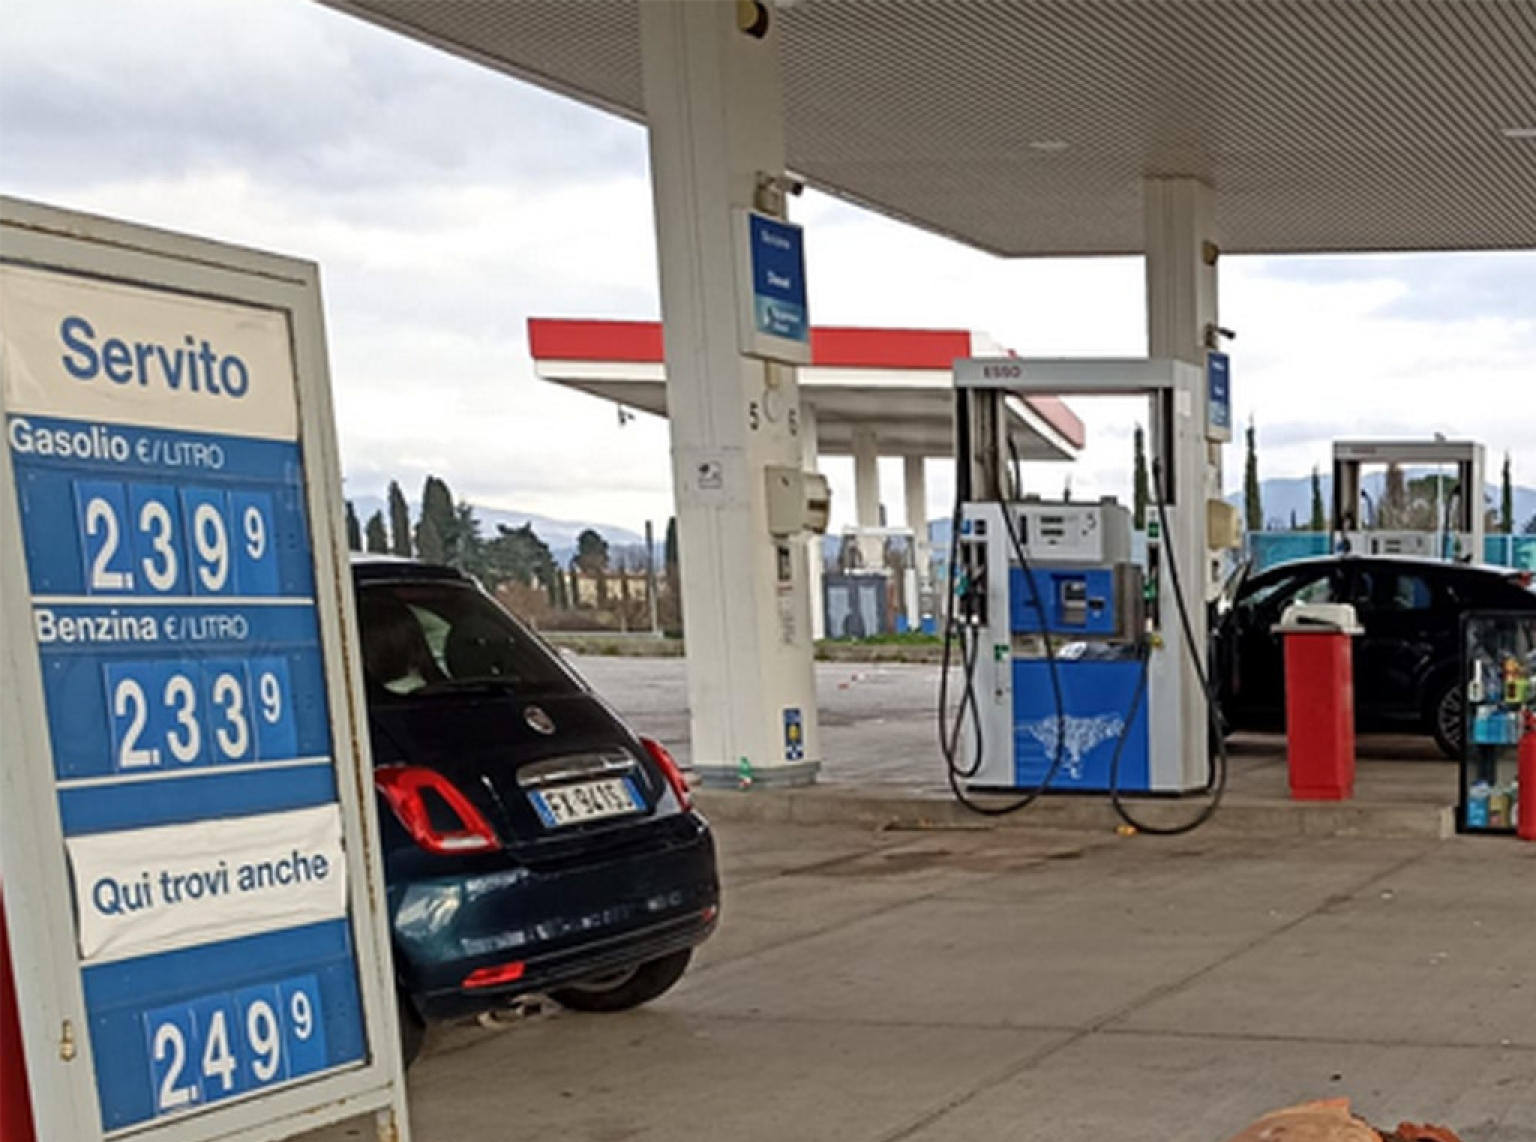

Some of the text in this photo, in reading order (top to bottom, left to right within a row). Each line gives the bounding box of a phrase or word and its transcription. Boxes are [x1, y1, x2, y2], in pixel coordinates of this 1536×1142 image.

[60, 316, 249, 398] Servito
[8, 417, 131, 462] Gasolio
[35, 608, 158, 643] Benzina
[92, 849, 329, 916] Qui trovi anche
